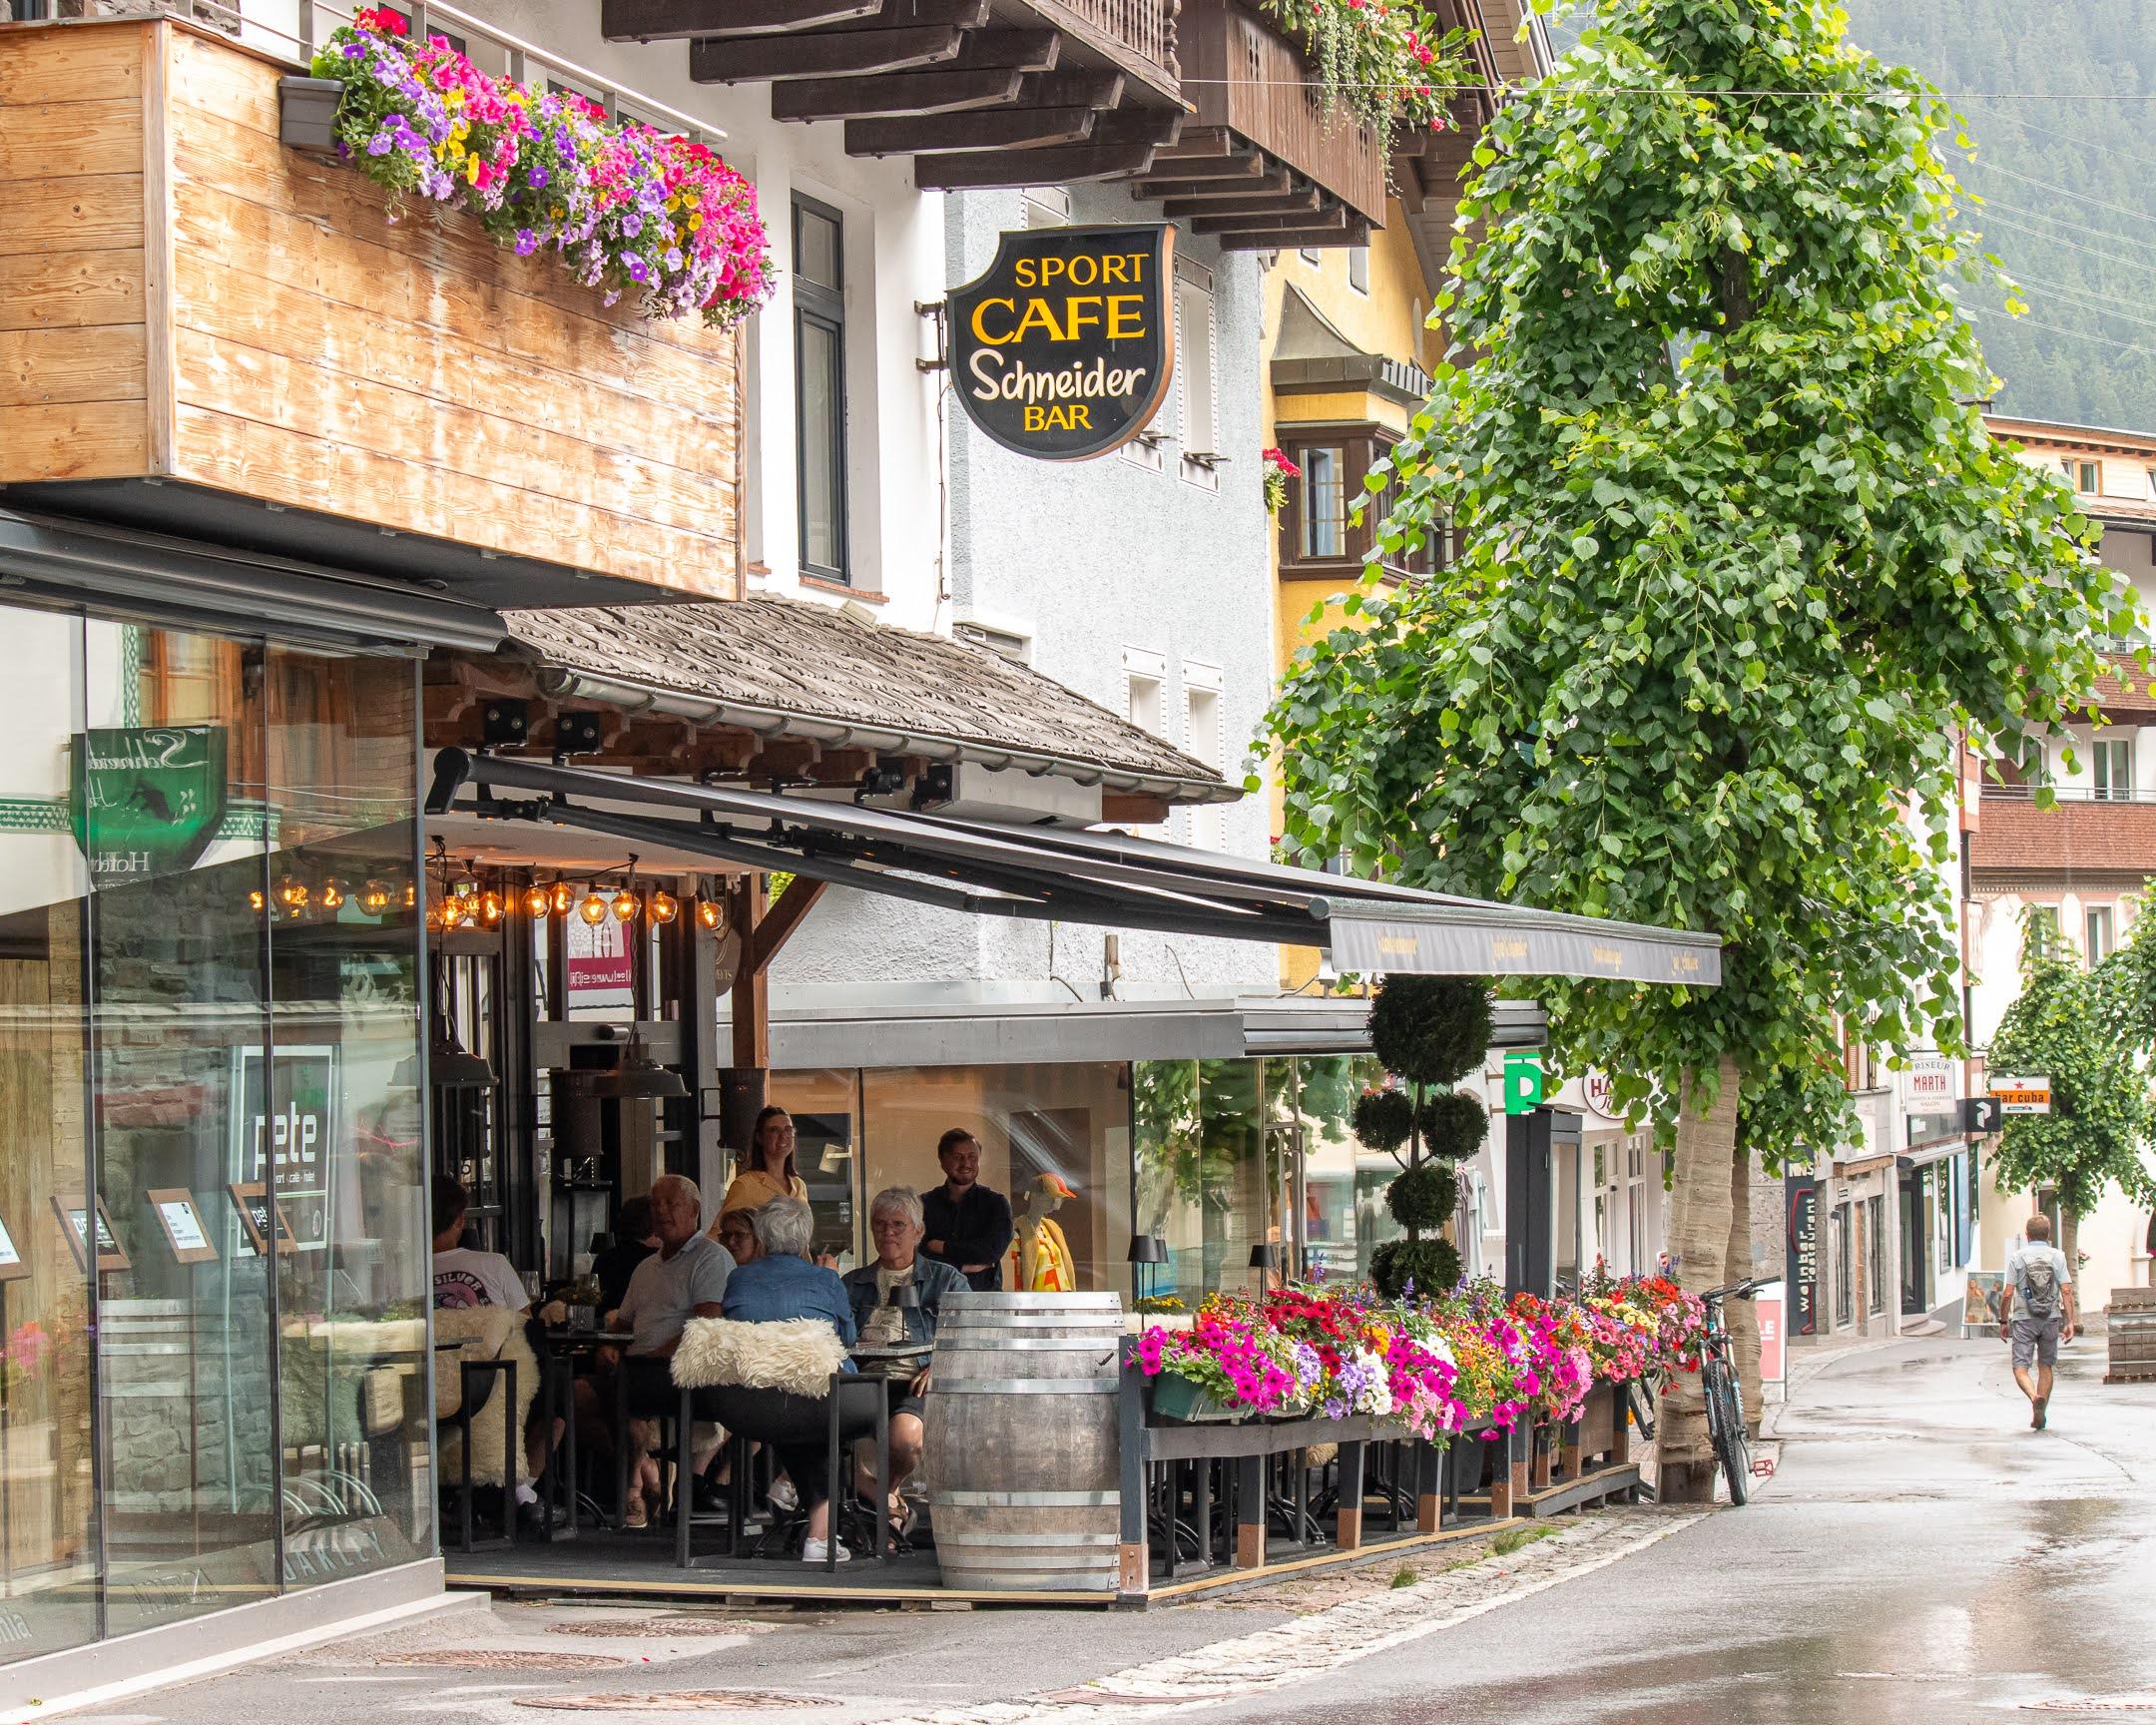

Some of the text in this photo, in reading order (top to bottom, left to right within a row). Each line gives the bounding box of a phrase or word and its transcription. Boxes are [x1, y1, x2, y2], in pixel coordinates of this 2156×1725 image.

[1014, 254, 1150, 288] SPORT
[971, 294, 1146, 345] CAFE
[969, 347, 1146, 404] Schneider
[1024, 403, 1093, 432] BAR
[1913, 1061, 1950, 1071] RISEUR
[1913, 1075, 1946, 1091] MARTH
[2017, 1091, 2044, 1103] cuba
[254, 1101, 317, 1180] pete
[1806, 1197, 1816, 1283] restaurant
